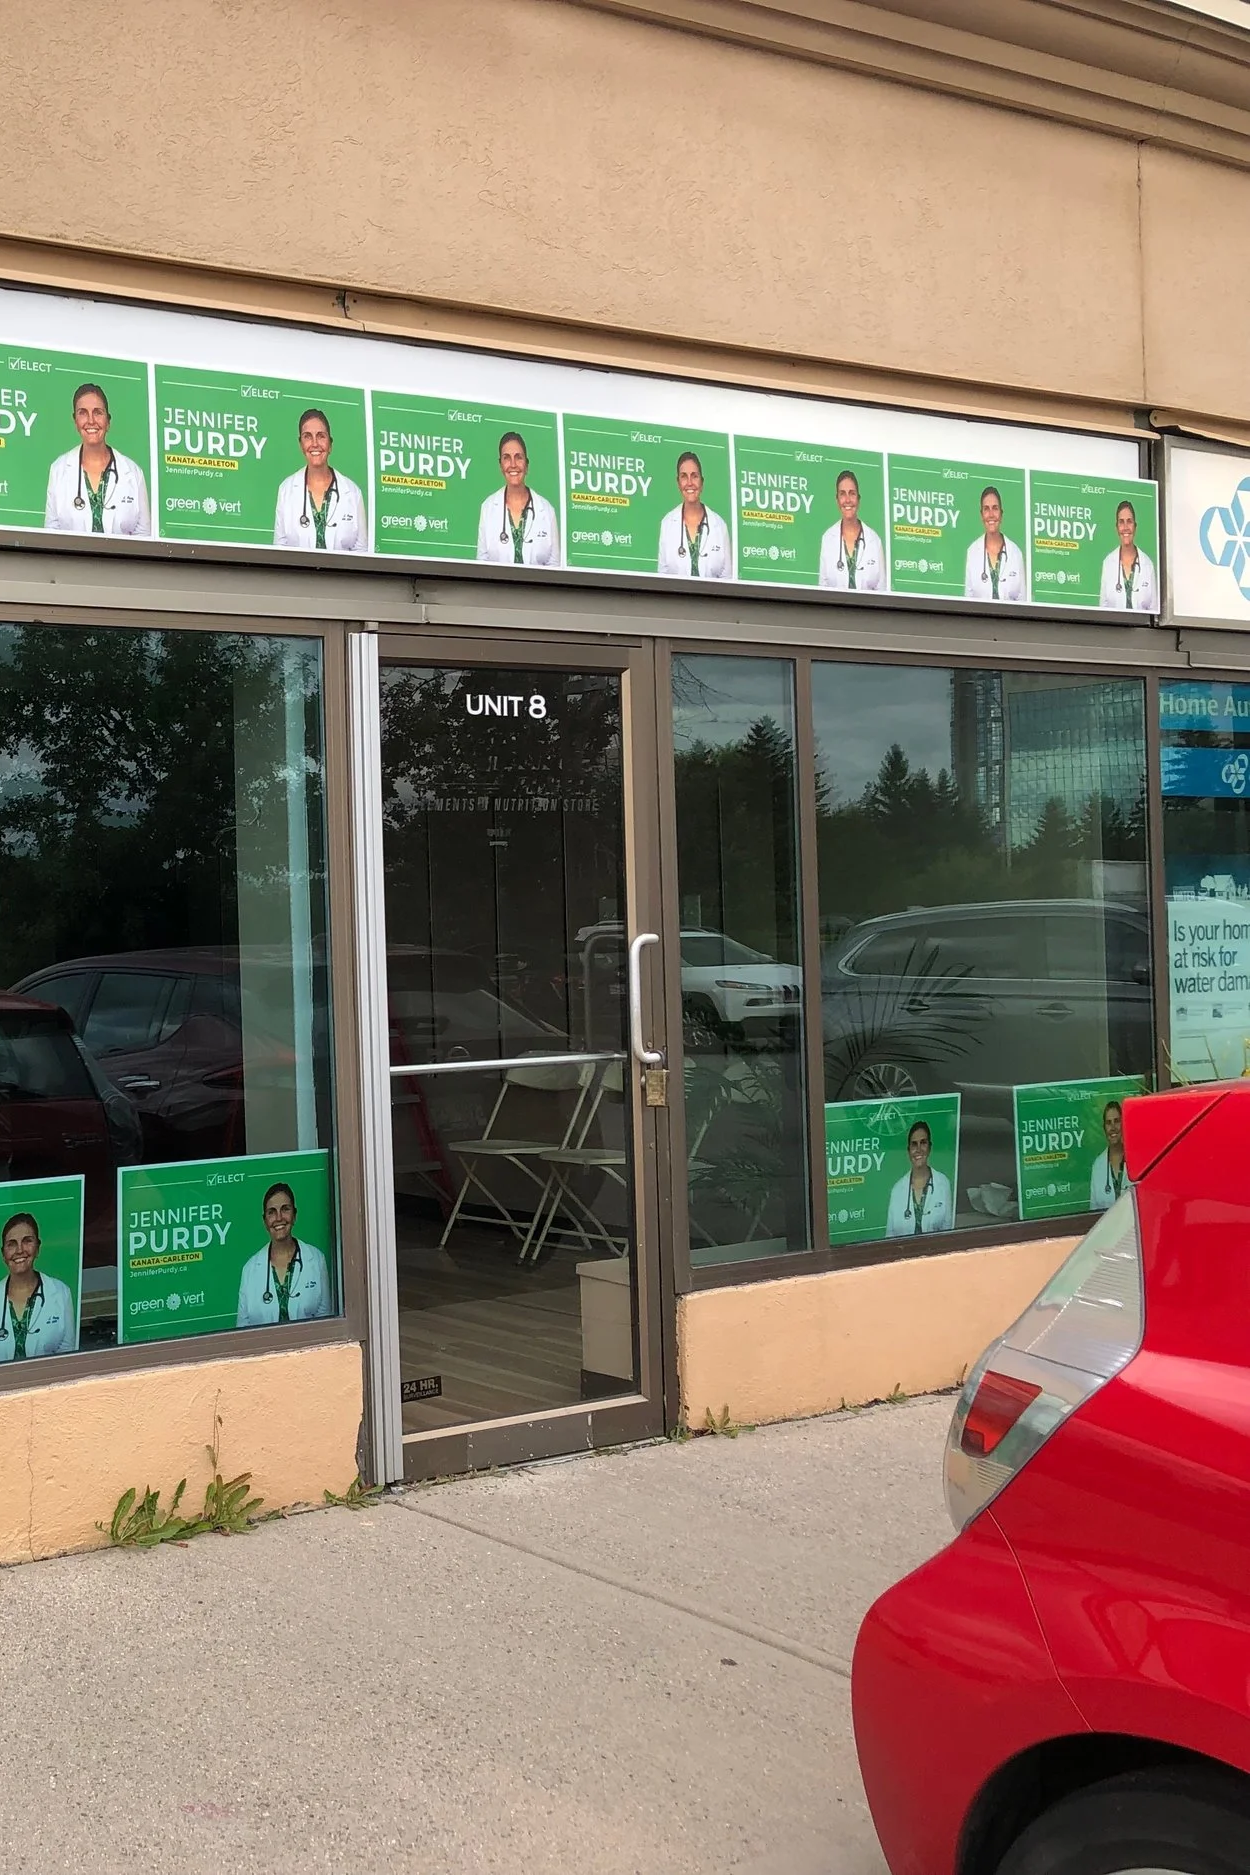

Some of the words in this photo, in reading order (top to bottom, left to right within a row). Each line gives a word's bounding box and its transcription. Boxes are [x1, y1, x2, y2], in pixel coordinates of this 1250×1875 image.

[20, 360, 52, 372] ELECT
[251, 388, 279, 399] ELECT
[164, 407, 257, 432] JENNIFER
[457, 412, 482, 422] ELECT
[163, 427, 266, 459] PURDY
[380, 430, 462, 453] JENNIFER
[166, 455, 236, 467] KANATA-CARLETON
[380, 449, 470, 479] PURDY
[570, 451, 644, 472] JENNIFER
[164, 466, 223, 477] JenniferPurdy.ca
[382, 476, 443, 487] KANATA-CARLETON
[741, 470, 807, 490] JENNIFER
[570, 468, 651, 496] PURDY
[165, 497, 200, 510] green
[219, 500, 241, 512] vert
[741, 487, 813, 513] PURDY
[893, 487, 953, 506] JENNIFER
[893, 503, 959, 528] PURDY
[1034, 502, 1091, 520] JENNIFER
[381, 515, 412, 527] green
[428, 518, 448, 529] vert
[1034, 517, 1096, 540] PURDY
[572, 531, 599, 542] green
[614, 533, 631, 544] vert
[742, 546, 767, 557] green
[780, 548, 795, 558] vert
[466, 694, 523, 717] UNIT
[528, 694, 547, 719] 8
[1158, 692, 1218, 716] Home
[1223, 695, 1250, 717] Au
[1174, 920, 1186, 941] Is
[1189, 925, 1220, 946] your
[1174, 948, 1188, 969] at
[1192, 946, 1217, 968] risk
[1219, 945, 1238, 967] for
[1175, 972, 1215, 993] water
[1218, 970, 1250, 992] dam
[1022, 1115, 1079, 1133] JENNIFER
[826, 1137, 880, 1155] NNIFER
[1022, 1130, 1085, 1154] PURDY
[828, 1152, 885, 1176] URDY
[217, 1173, 245, 1183] ELECT
[129, 1203, 222, 1228] JENNIFER
[129, 1221, 231, 1255] PURDY
[131, 1252, 200, 1267] KANATA-CARLETON
[129, 1266, 188, 1277] JenniferPurdy.ca
[129, 1298, 164, 1315] green
[182, 1290, 204, 1304] vert
[403, 1382, 417, 1394] 24
[420, 1378, 439, 1391] HR.
